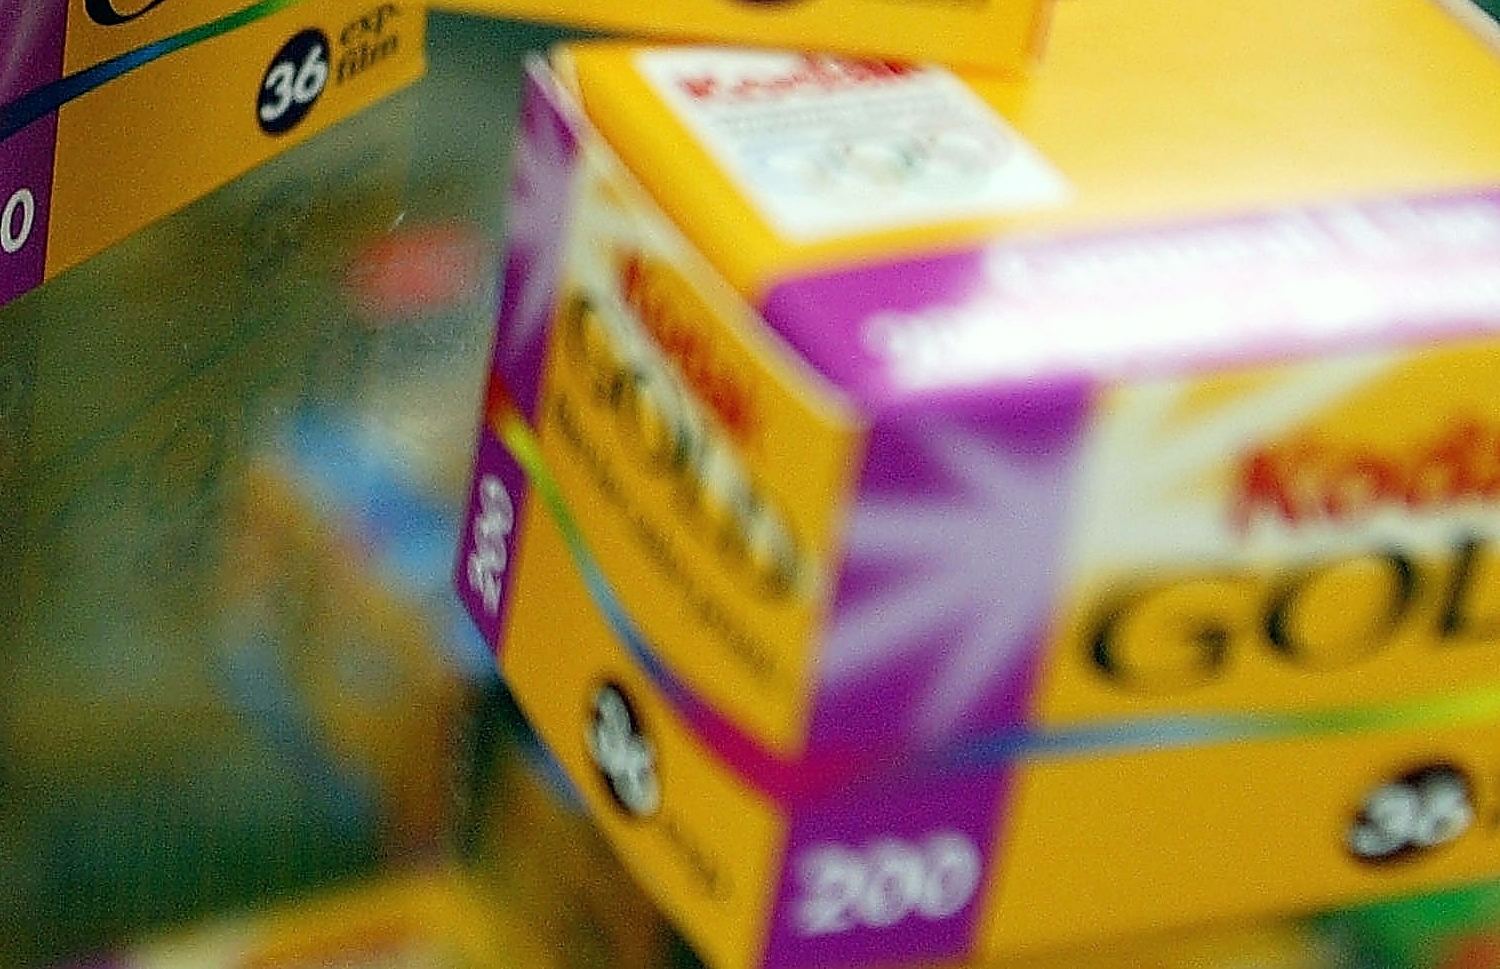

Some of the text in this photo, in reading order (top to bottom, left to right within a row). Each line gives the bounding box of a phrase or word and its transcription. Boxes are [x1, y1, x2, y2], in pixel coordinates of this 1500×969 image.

[259, 44, 330, 124] 36
[1348, 777, 1476, 859] 36
[792, 831, 984, 938] 200
